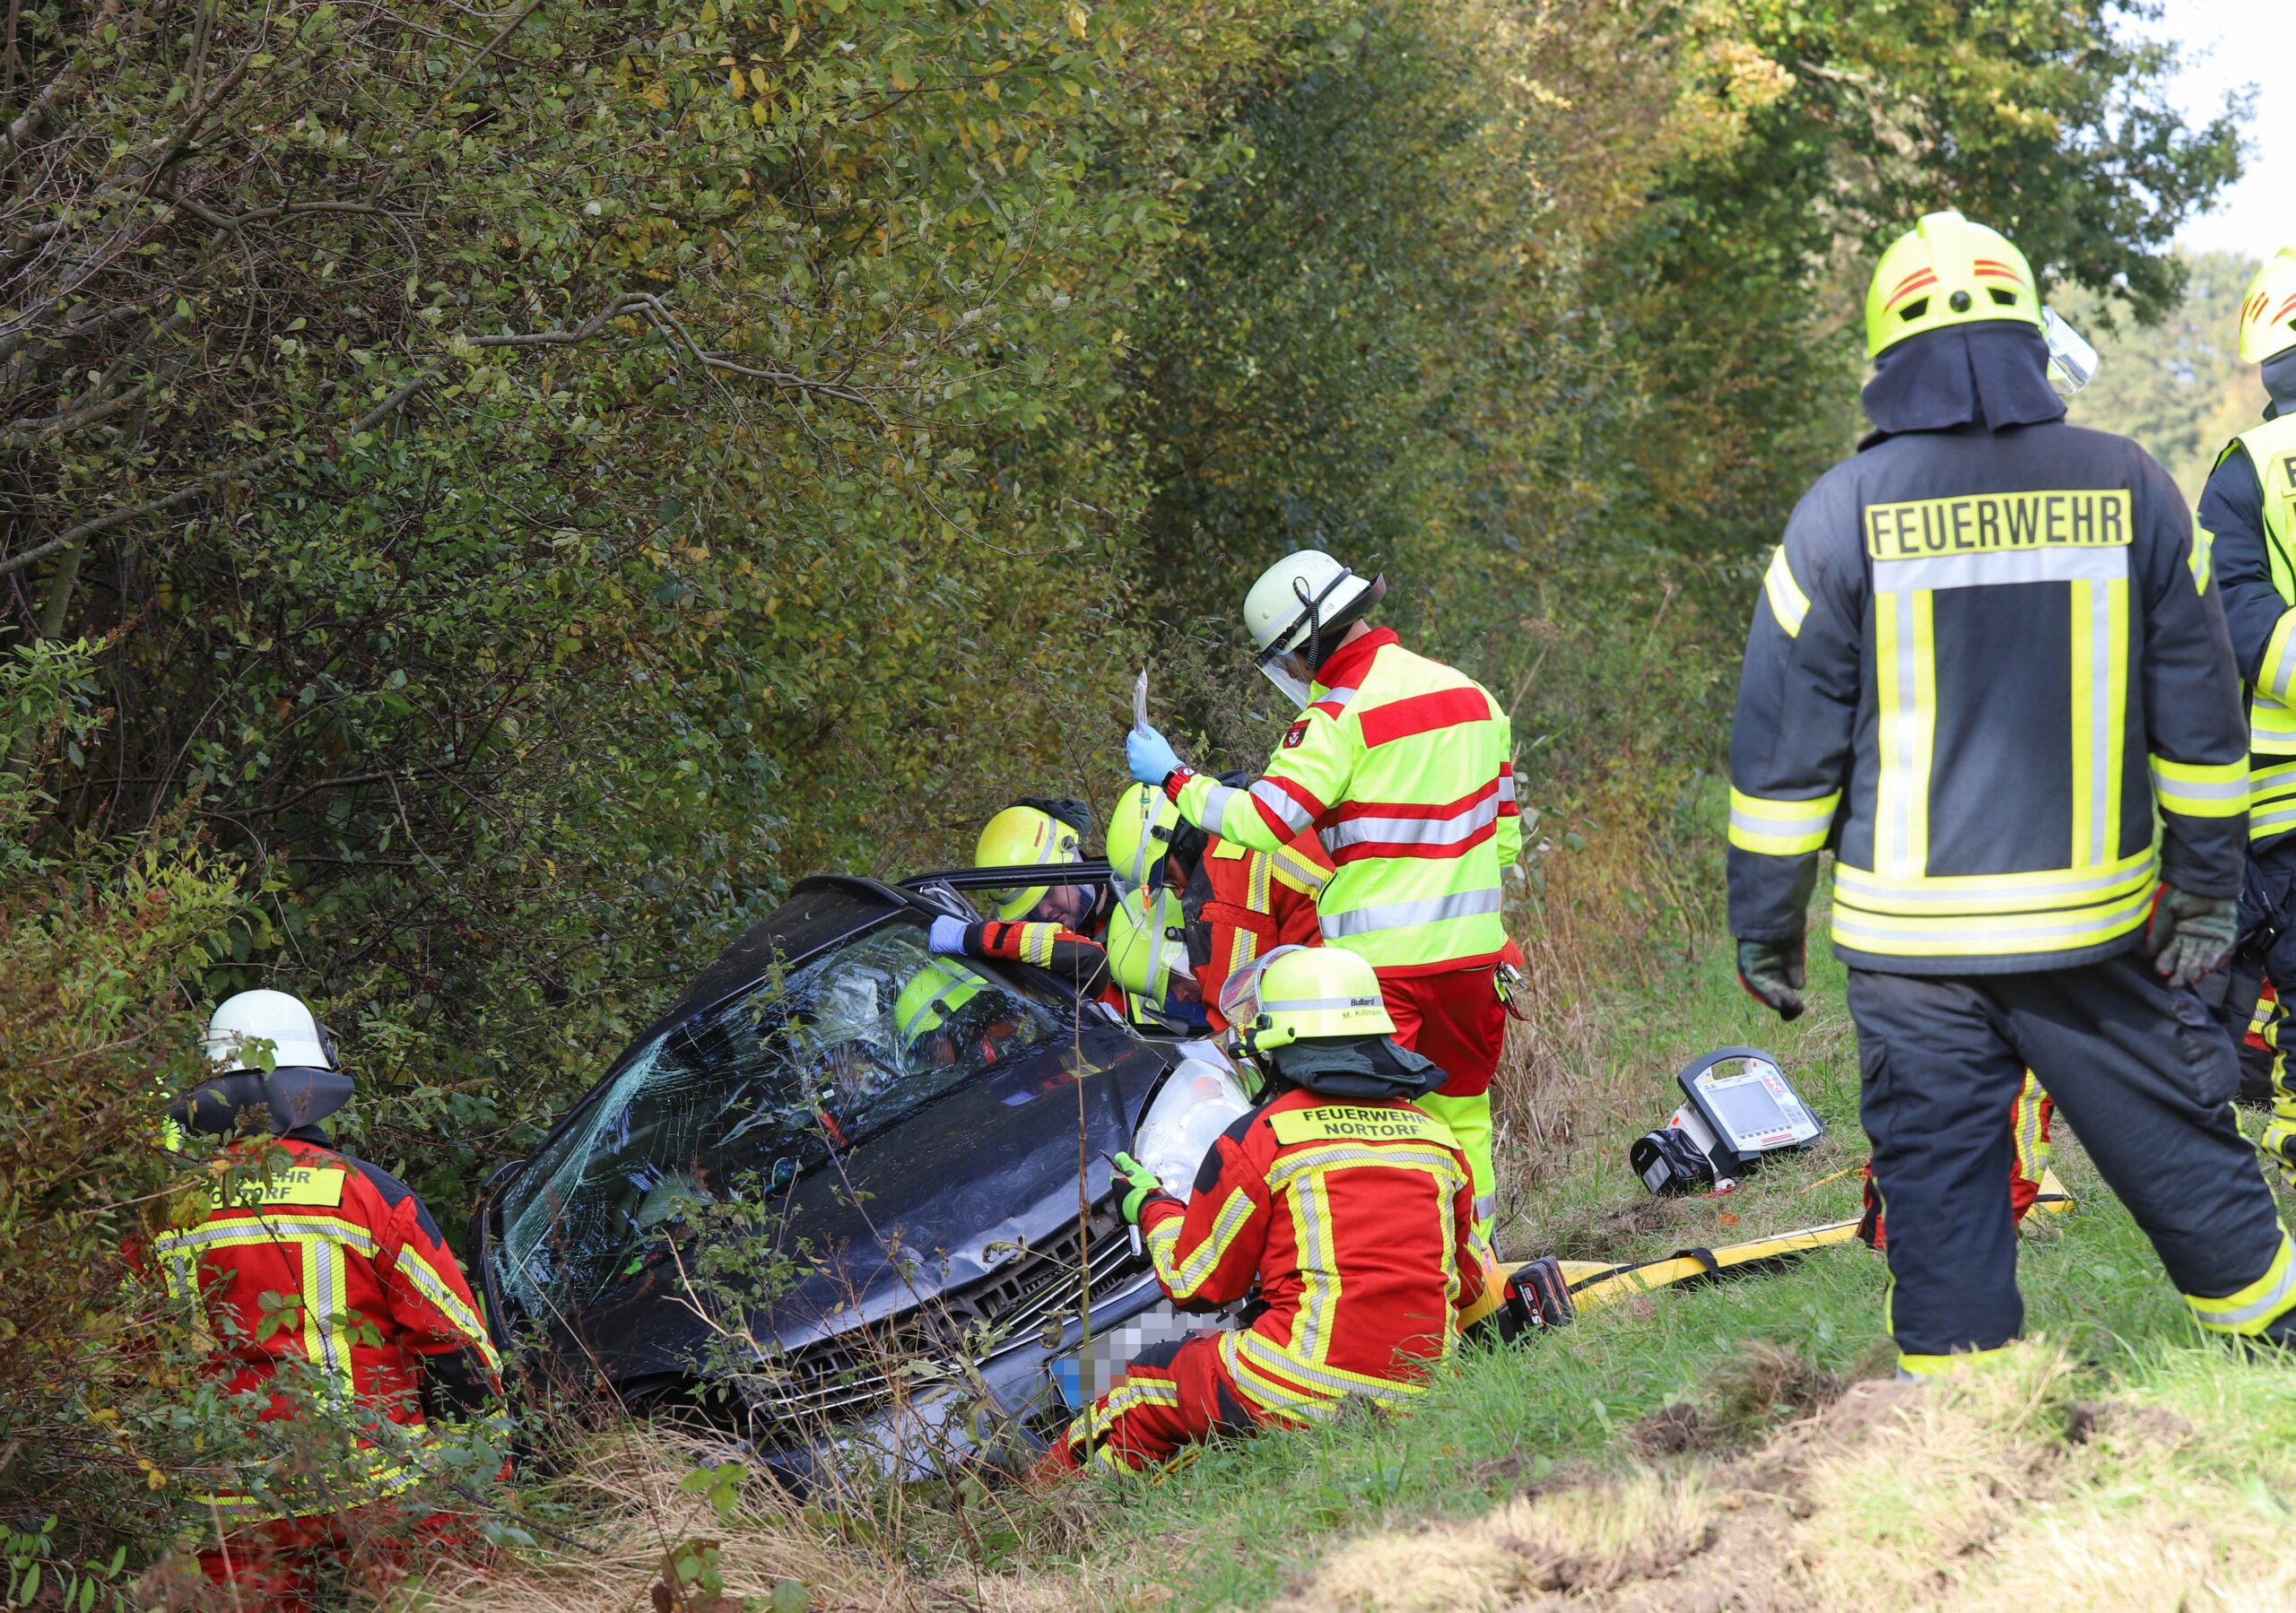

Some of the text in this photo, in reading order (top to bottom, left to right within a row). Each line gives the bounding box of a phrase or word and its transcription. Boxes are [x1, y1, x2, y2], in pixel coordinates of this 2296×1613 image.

[1871, 496, 2123, 554] FEUERWEHR
[1351, 998, 1374, 1006] Bullard
[1303, 1108, 1429, 1125] FEUERWEHR
[1325, 1123, 1421, 1137] NORTORF
